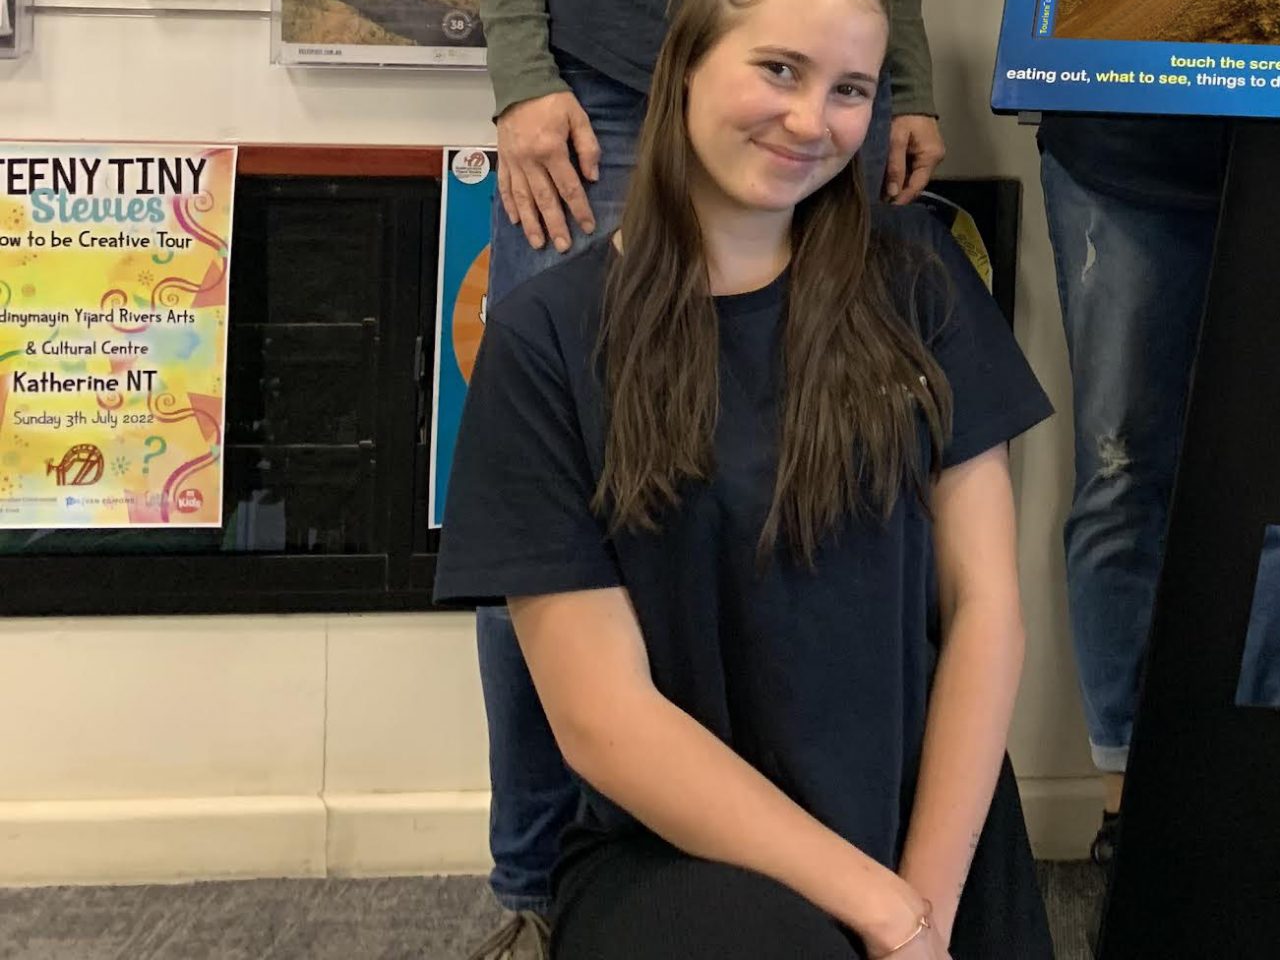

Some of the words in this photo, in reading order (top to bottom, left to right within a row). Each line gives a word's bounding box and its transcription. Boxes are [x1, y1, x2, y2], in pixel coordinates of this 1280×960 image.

[450, 20, 464, 30] 38
[1171, 55, 1216, 68] touch
[1220, 56, 1245, 69] the
[1006, 67, 1056, 83] eating
[1060, 69, 1091, 84] out,
[1096, 69, 1135, 83] what
[1139, 71, 1155, 83] to
[1159, 74, 1191, 87] see,
[1196, 73, 1246, 88] things
[1250, 74, 1266, 87] to
[108, 158, 207, 195] TINY
[30, 188, 165, 223] Stevies
[0, 236, 21, 247] ow
[27, 233, 46, 248] to
[51, 231, 73, 247] be
[78, 231, 150, 248] Creative
[157, 231, 192, 248] Tour
[0, 309, 69, 327] dinymayin
[75, 308, 114, 328] Yijard
[119, 308, 162, 324] Rivers
[167, 309, 195, 324] Arts
[25, 341, 37, 355] &
[42, 340, 96, 355] Cultural
[101, 341, 149, 355] Centre
[13, 370, 119, 393] Katherine
[127, 370, 157, 391] NT
[14, 411, 61, 429] Sunday
[67, 412, 86, 427] 3th
[91, 411, 118, 428] July
[122, 415, 154, 424] 2022
